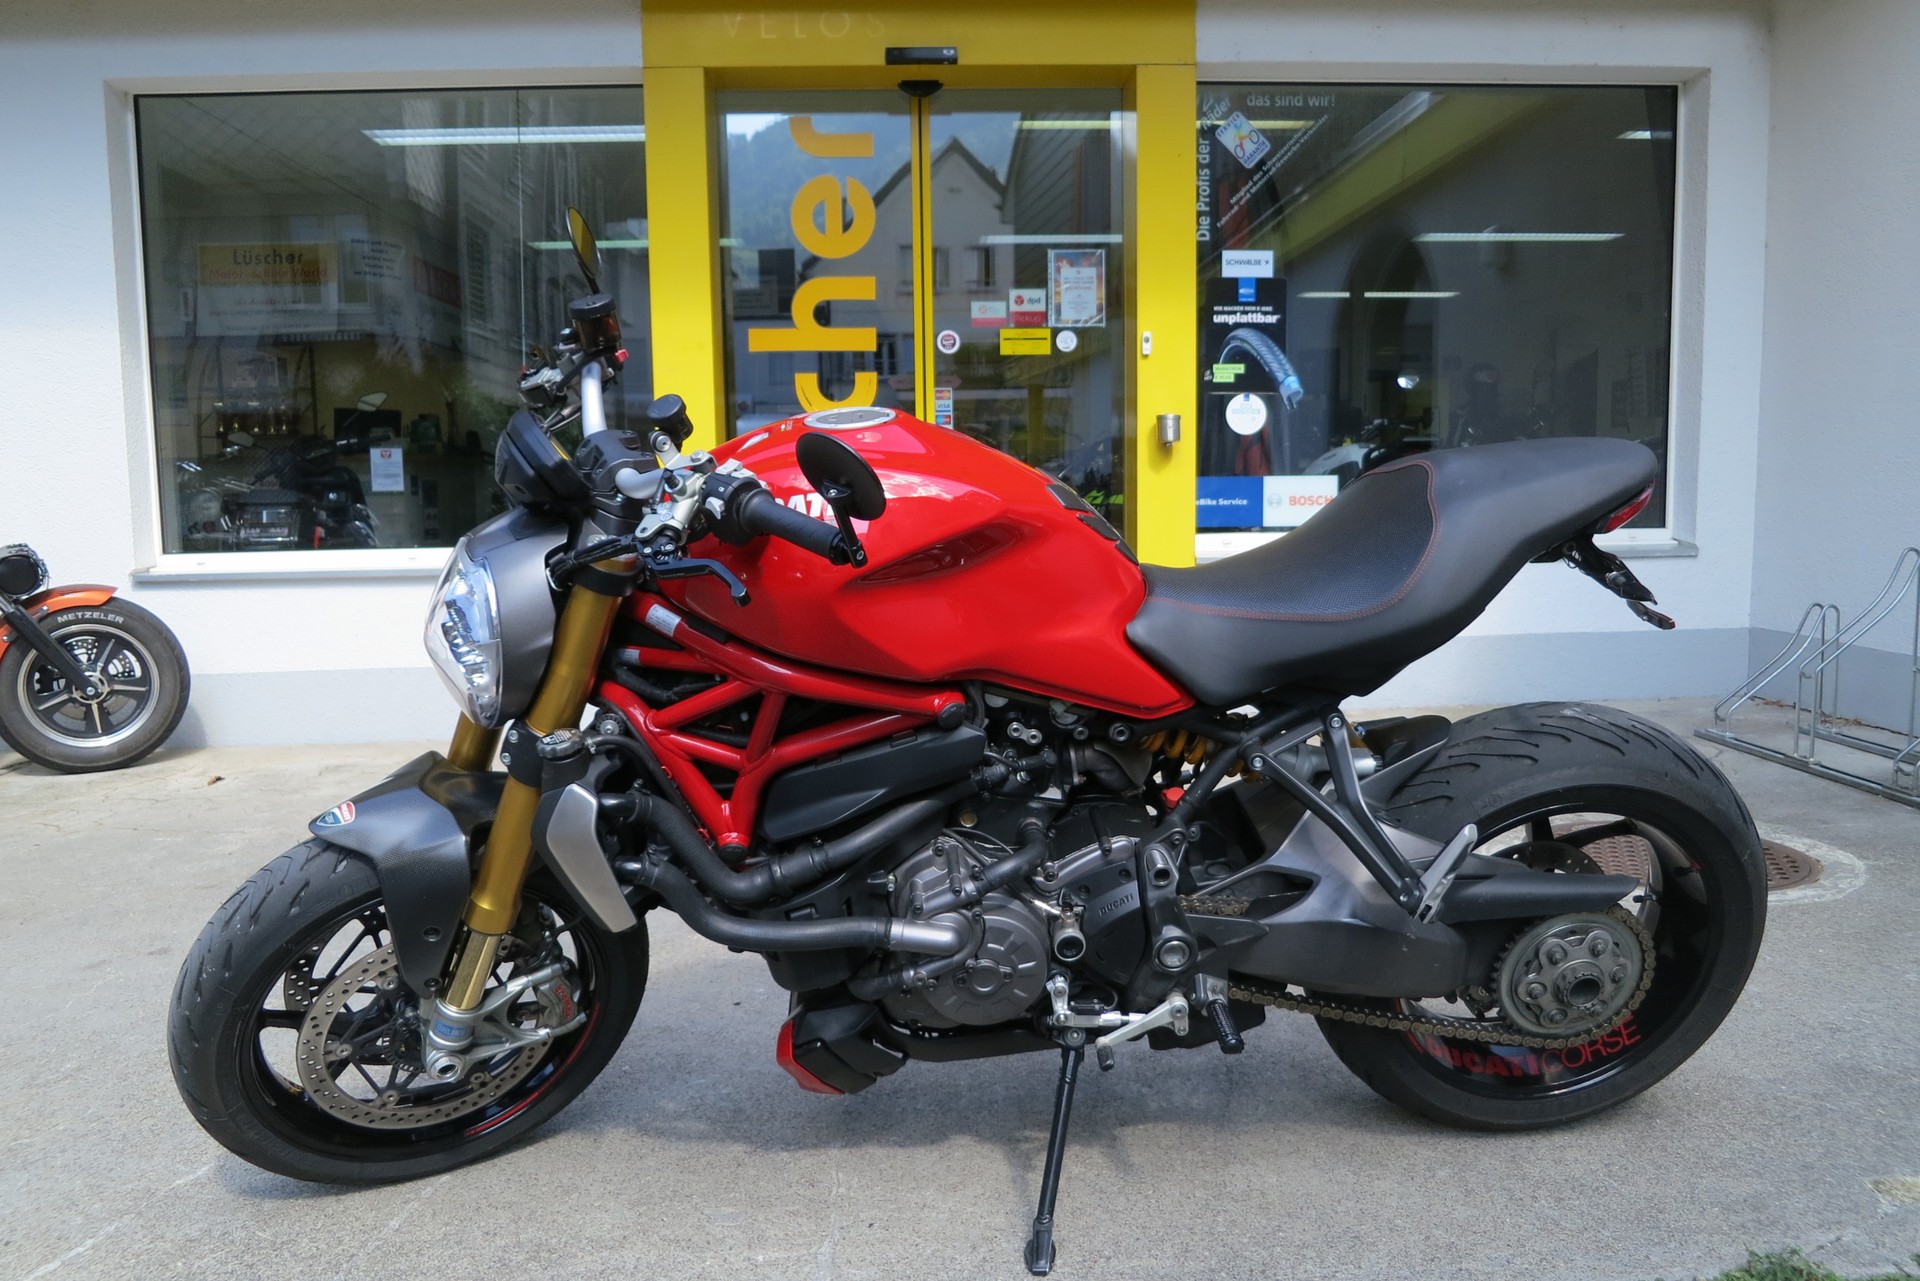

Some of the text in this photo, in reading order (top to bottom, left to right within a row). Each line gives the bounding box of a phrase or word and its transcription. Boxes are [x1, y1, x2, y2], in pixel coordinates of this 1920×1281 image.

[1247, 93, 1336, 107] das sind wir!
[1242, 141, 1267, 165] GARANTIE
[1196, 138, 1210, 241] Die Profis der
[233, 248, 304, 266] Lüscher
[291, 267, 328, 279] World
[1026, 297, 1041, 305] dpd
[1014, 314, 1042, 323] Pickup
[1213, 312, 1279, 325] unplattbar
[1218, 497, 1248, 505] Service
[57, 611, 124, 624] METZELER
[1098, 892, 1134, 916] DUCATI
[1541, 1014, 1642, 1073] CORSE
